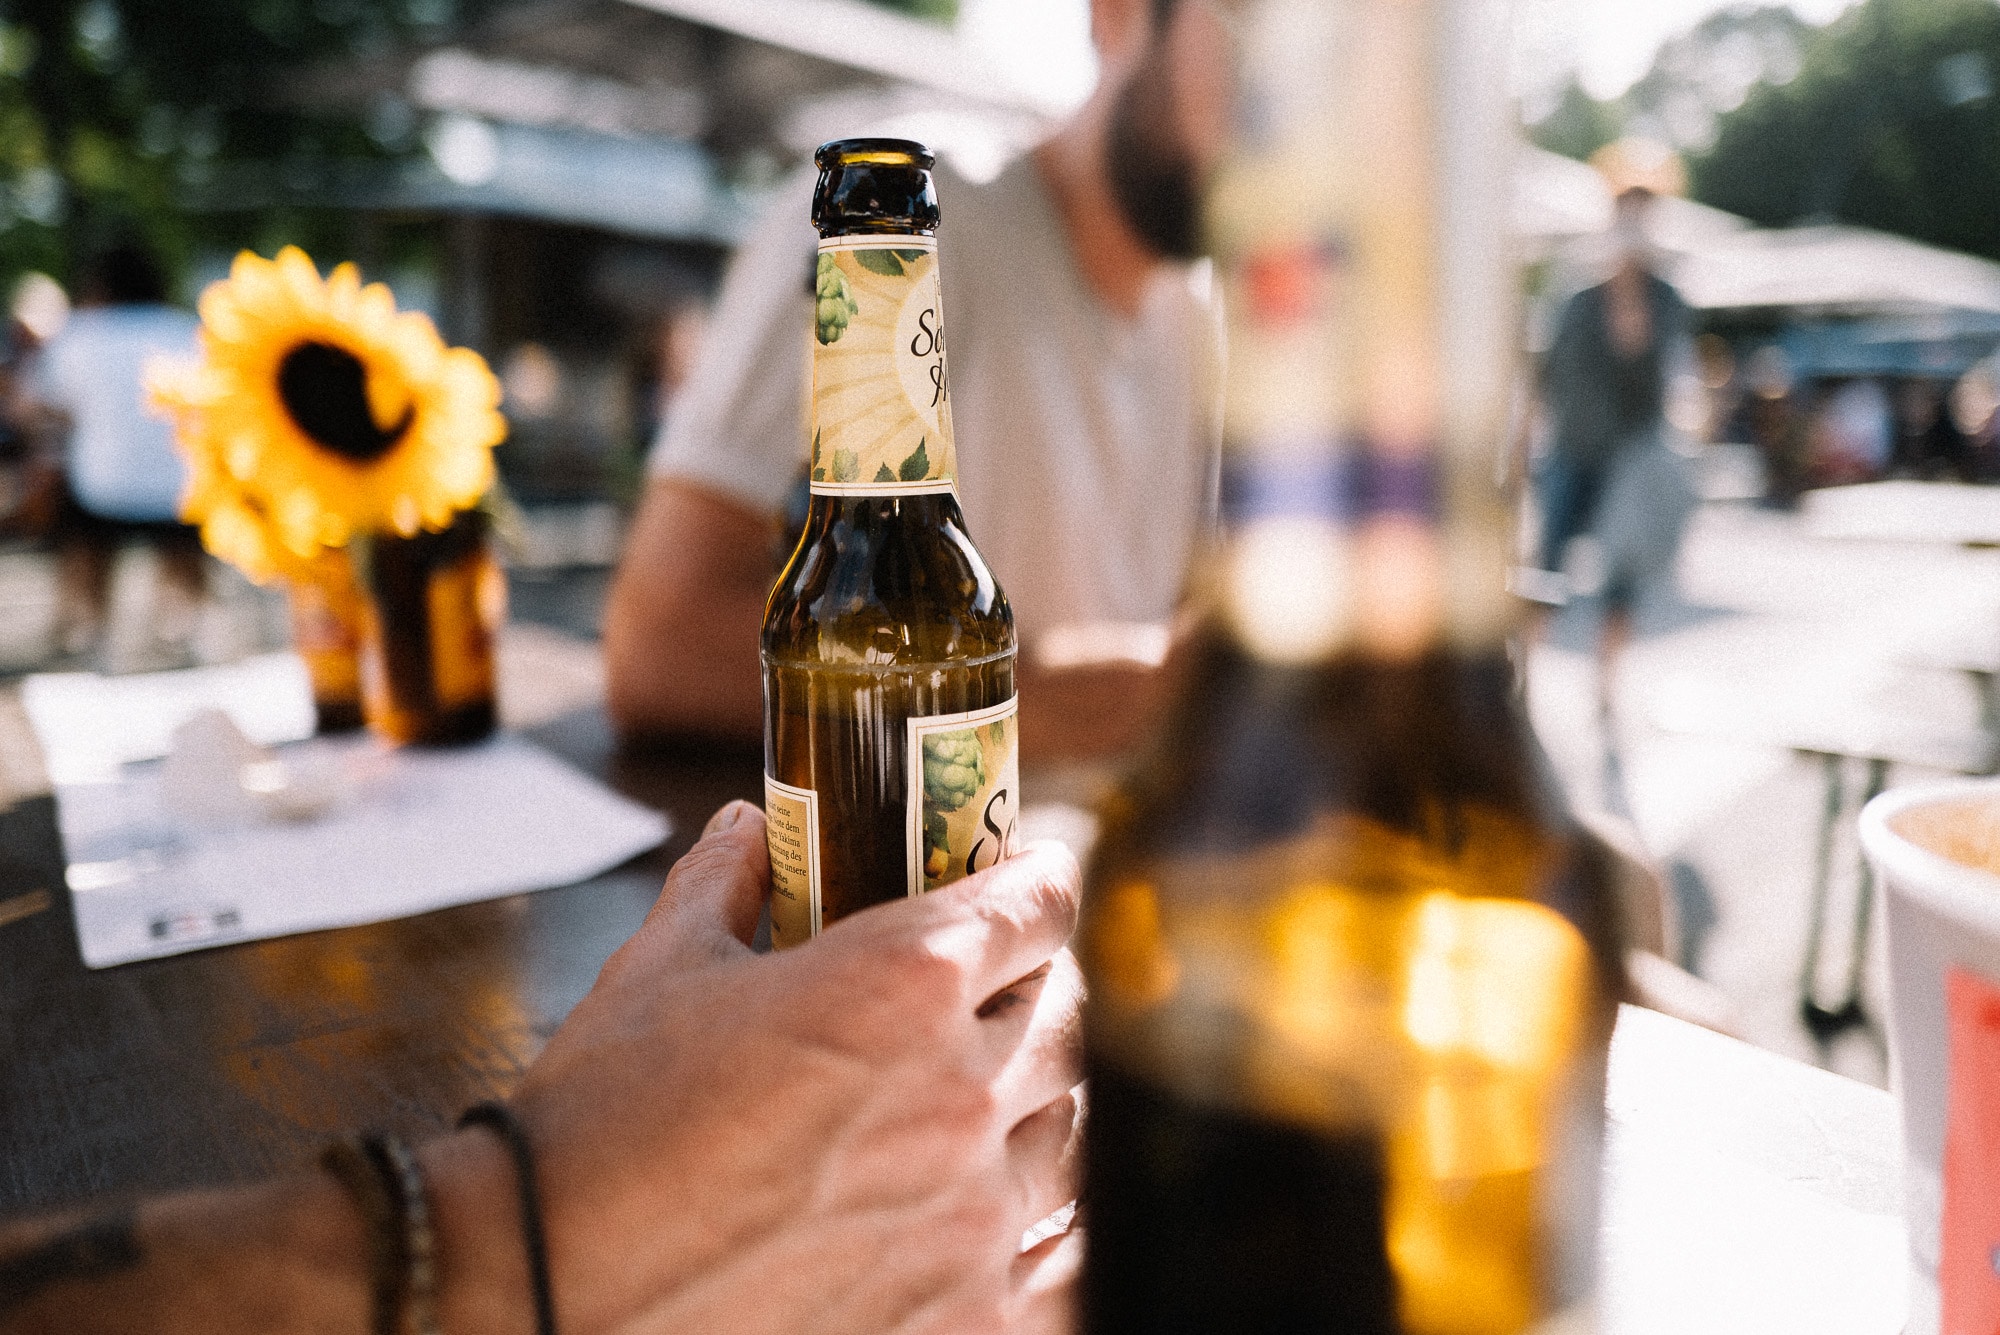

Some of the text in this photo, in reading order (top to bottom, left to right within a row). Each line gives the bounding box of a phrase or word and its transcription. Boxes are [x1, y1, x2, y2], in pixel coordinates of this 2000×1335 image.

[777, 805, 791, 817] seine
[786, 821, 800, 834] dem
[778, 831, 801, 848] Yakima
[790, 849, 802, 861] des
[784, 863, 807, 877] unsere
